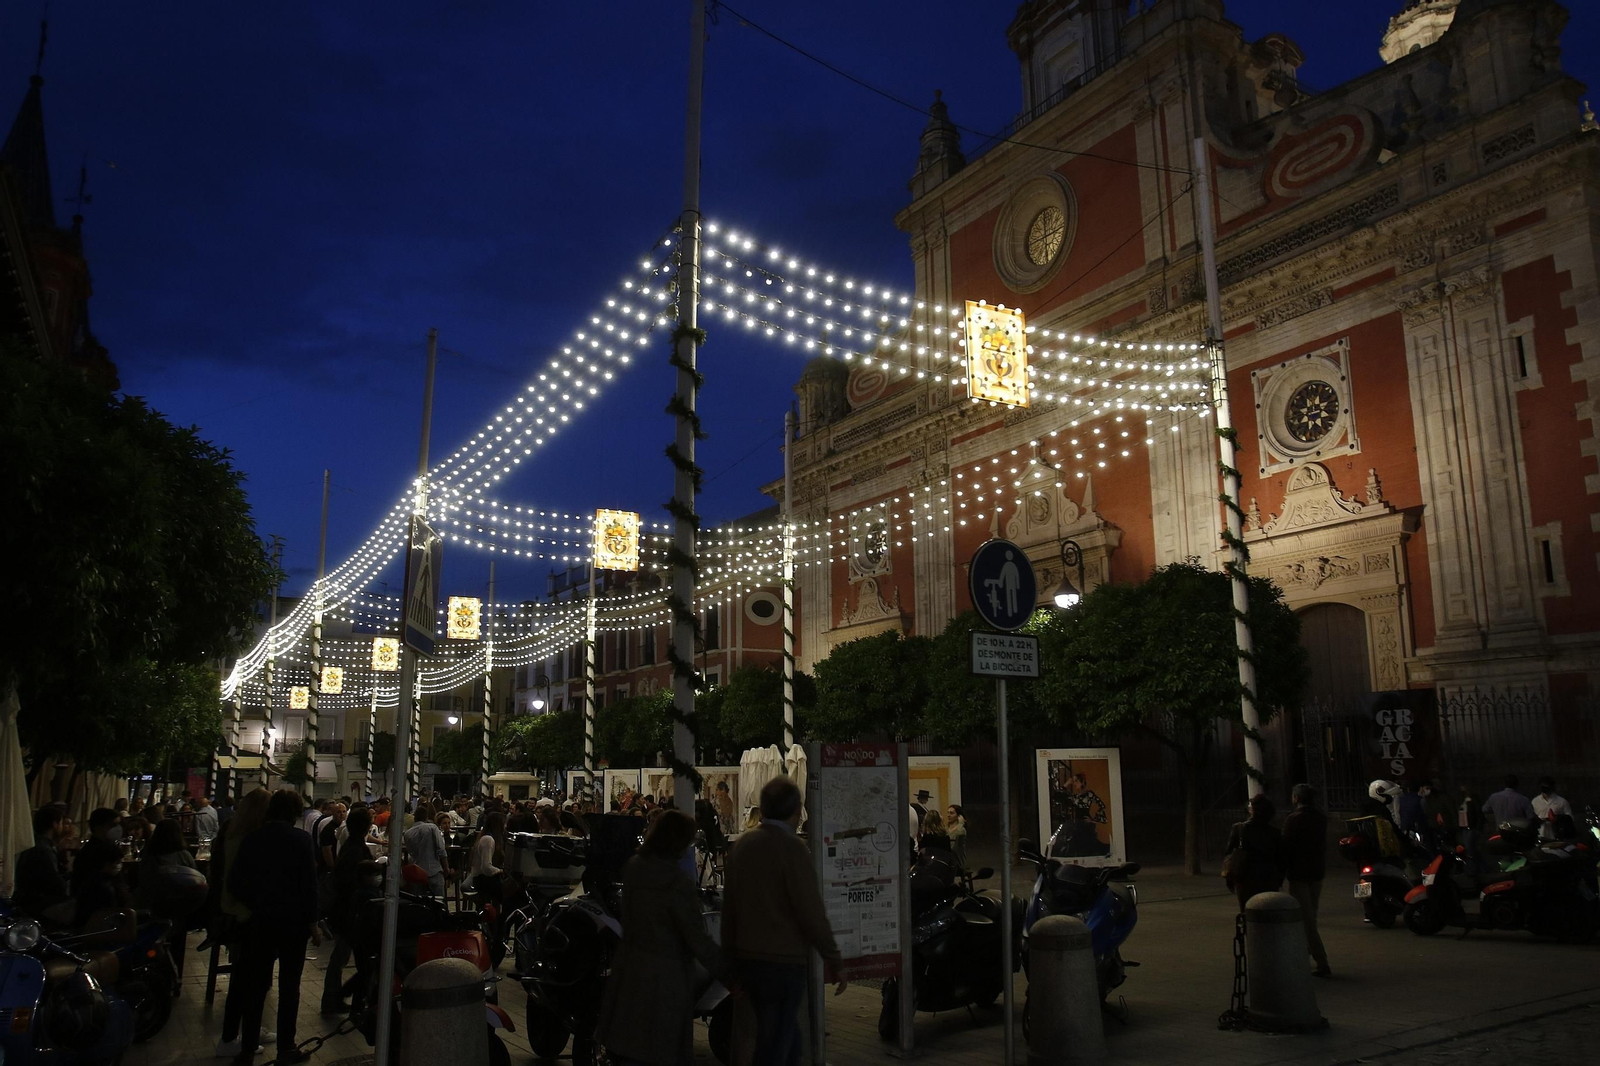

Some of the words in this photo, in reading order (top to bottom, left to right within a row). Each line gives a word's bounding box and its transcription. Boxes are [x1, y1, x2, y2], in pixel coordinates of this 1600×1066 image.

[977, 638, 987, 646] DE
[990, 638, 997, 646] 10
[999, 639, 1007, 648] H.
[1009, 640, 1014, 648] A
[1016, 641, 1025, 649] 22
[1026, 641, 1034, 649] H.
[978, 650, 1021, 660] DESMONTE
[1023, 652, 1033, 661] DE
[980, 661, 990, 670] LA
[993, 663, 1031, 672] BICICLETA
[848, 891, 874, 903] PORTES
